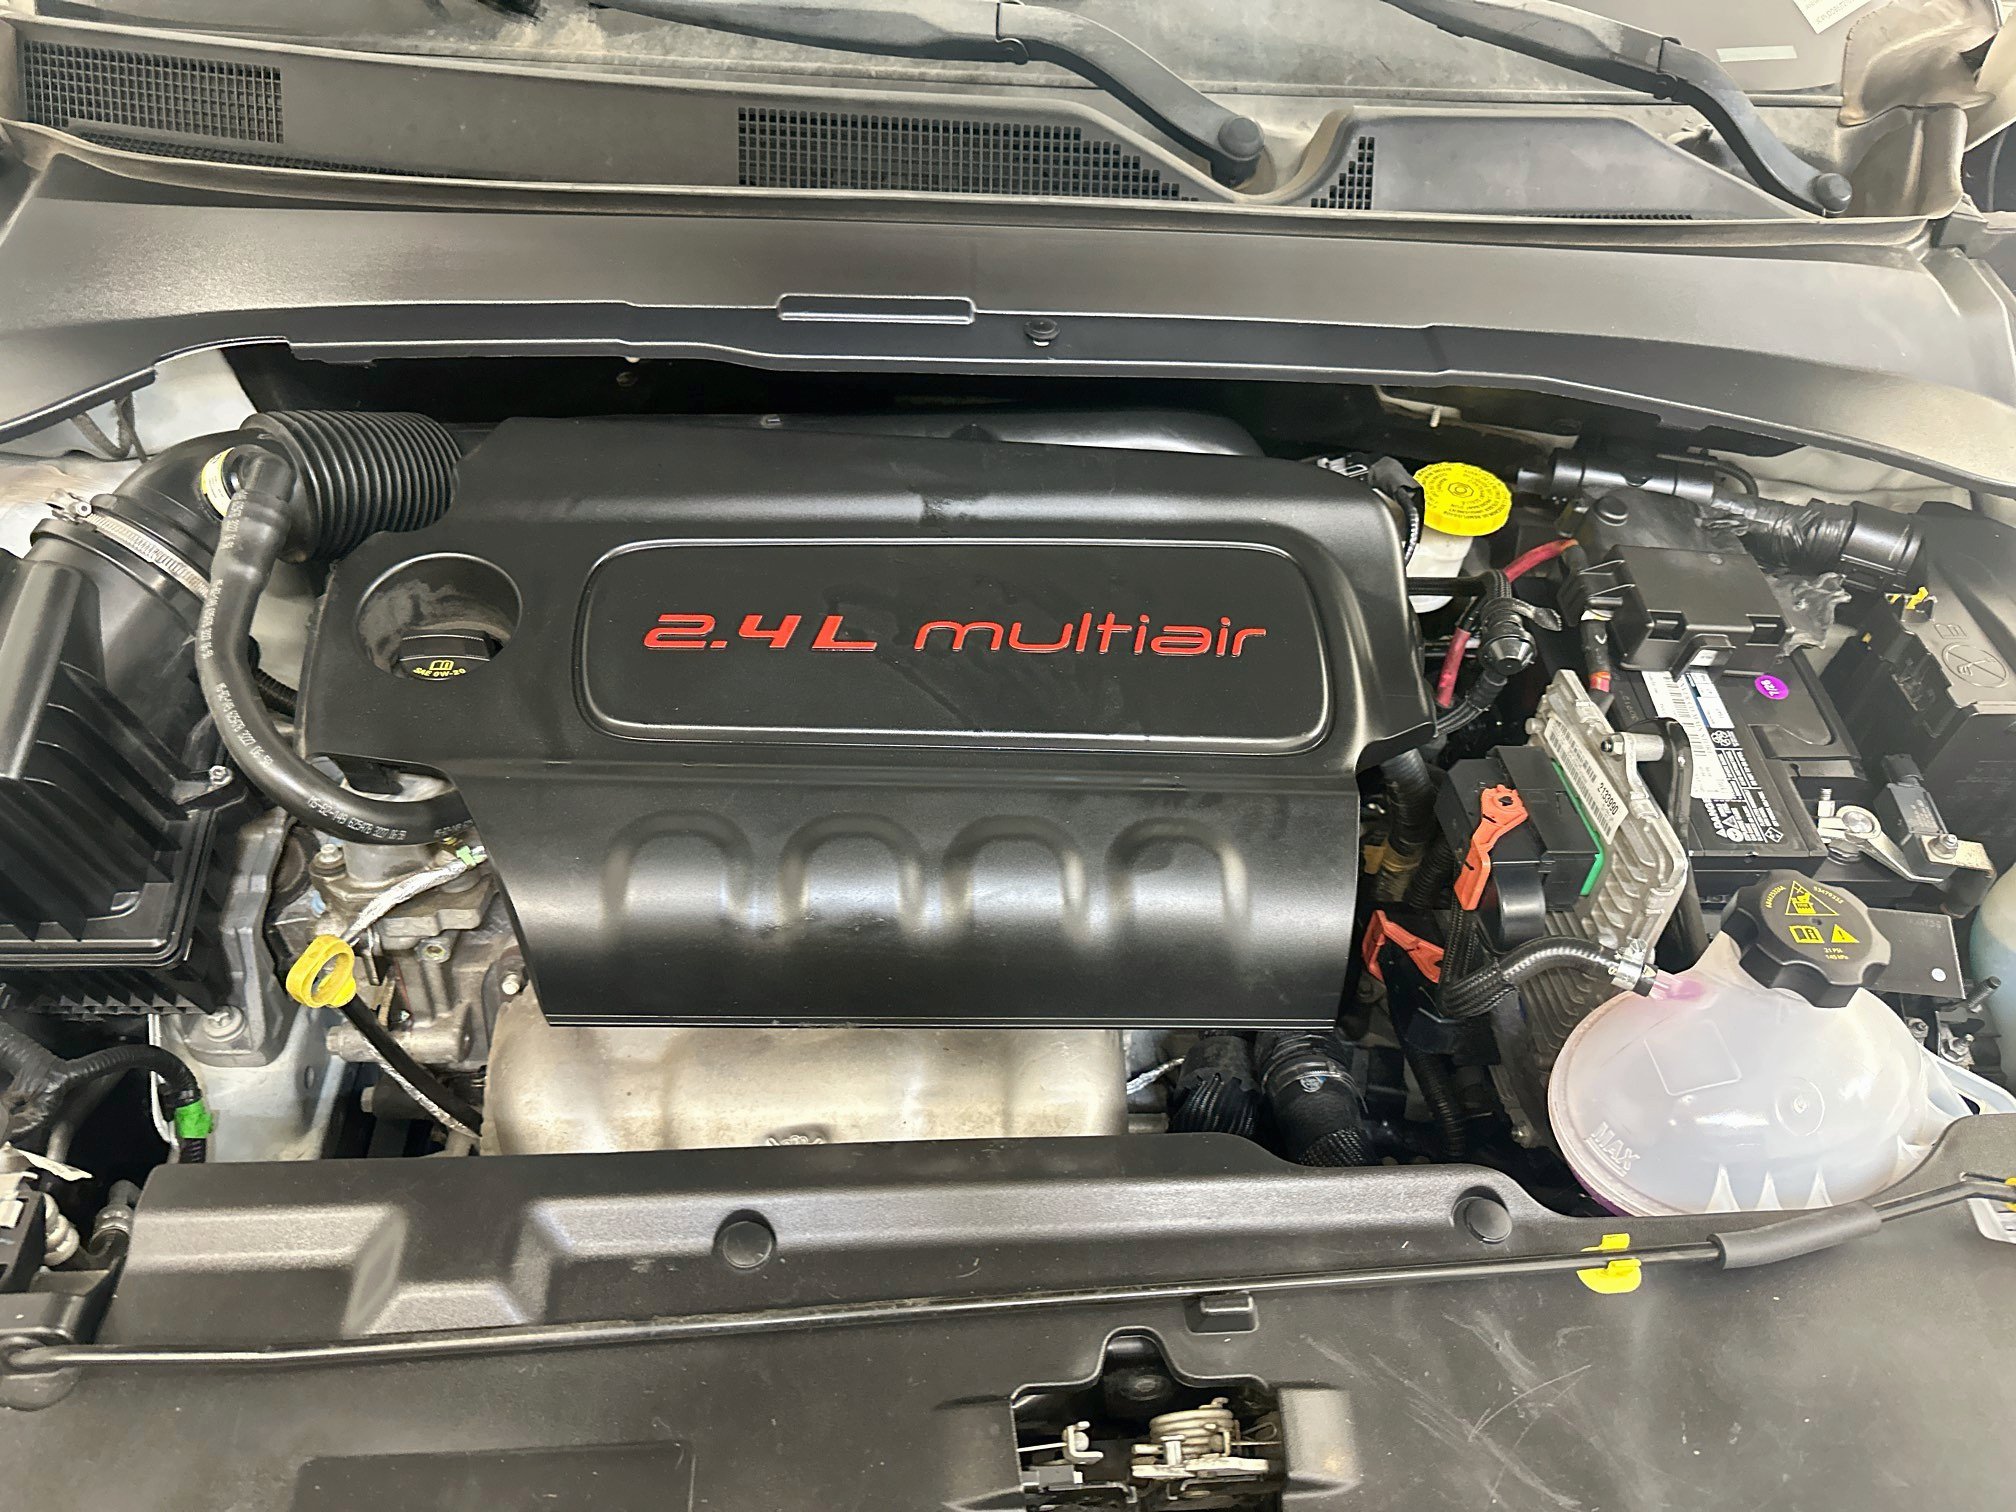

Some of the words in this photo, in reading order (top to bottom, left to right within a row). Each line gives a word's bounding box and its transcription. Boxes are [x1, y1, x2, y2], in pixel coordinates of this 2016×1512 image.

[914, 612, 1267, 657] multiair
[412, 667, 433, 677] SAE
[433, 668, 467, 677] 0W-20
[1597, 782, 1619, 815] 2133990
[1701, 797, 1724, 829] DANGE
[1591, 1121, 1640, 1171] MAX
